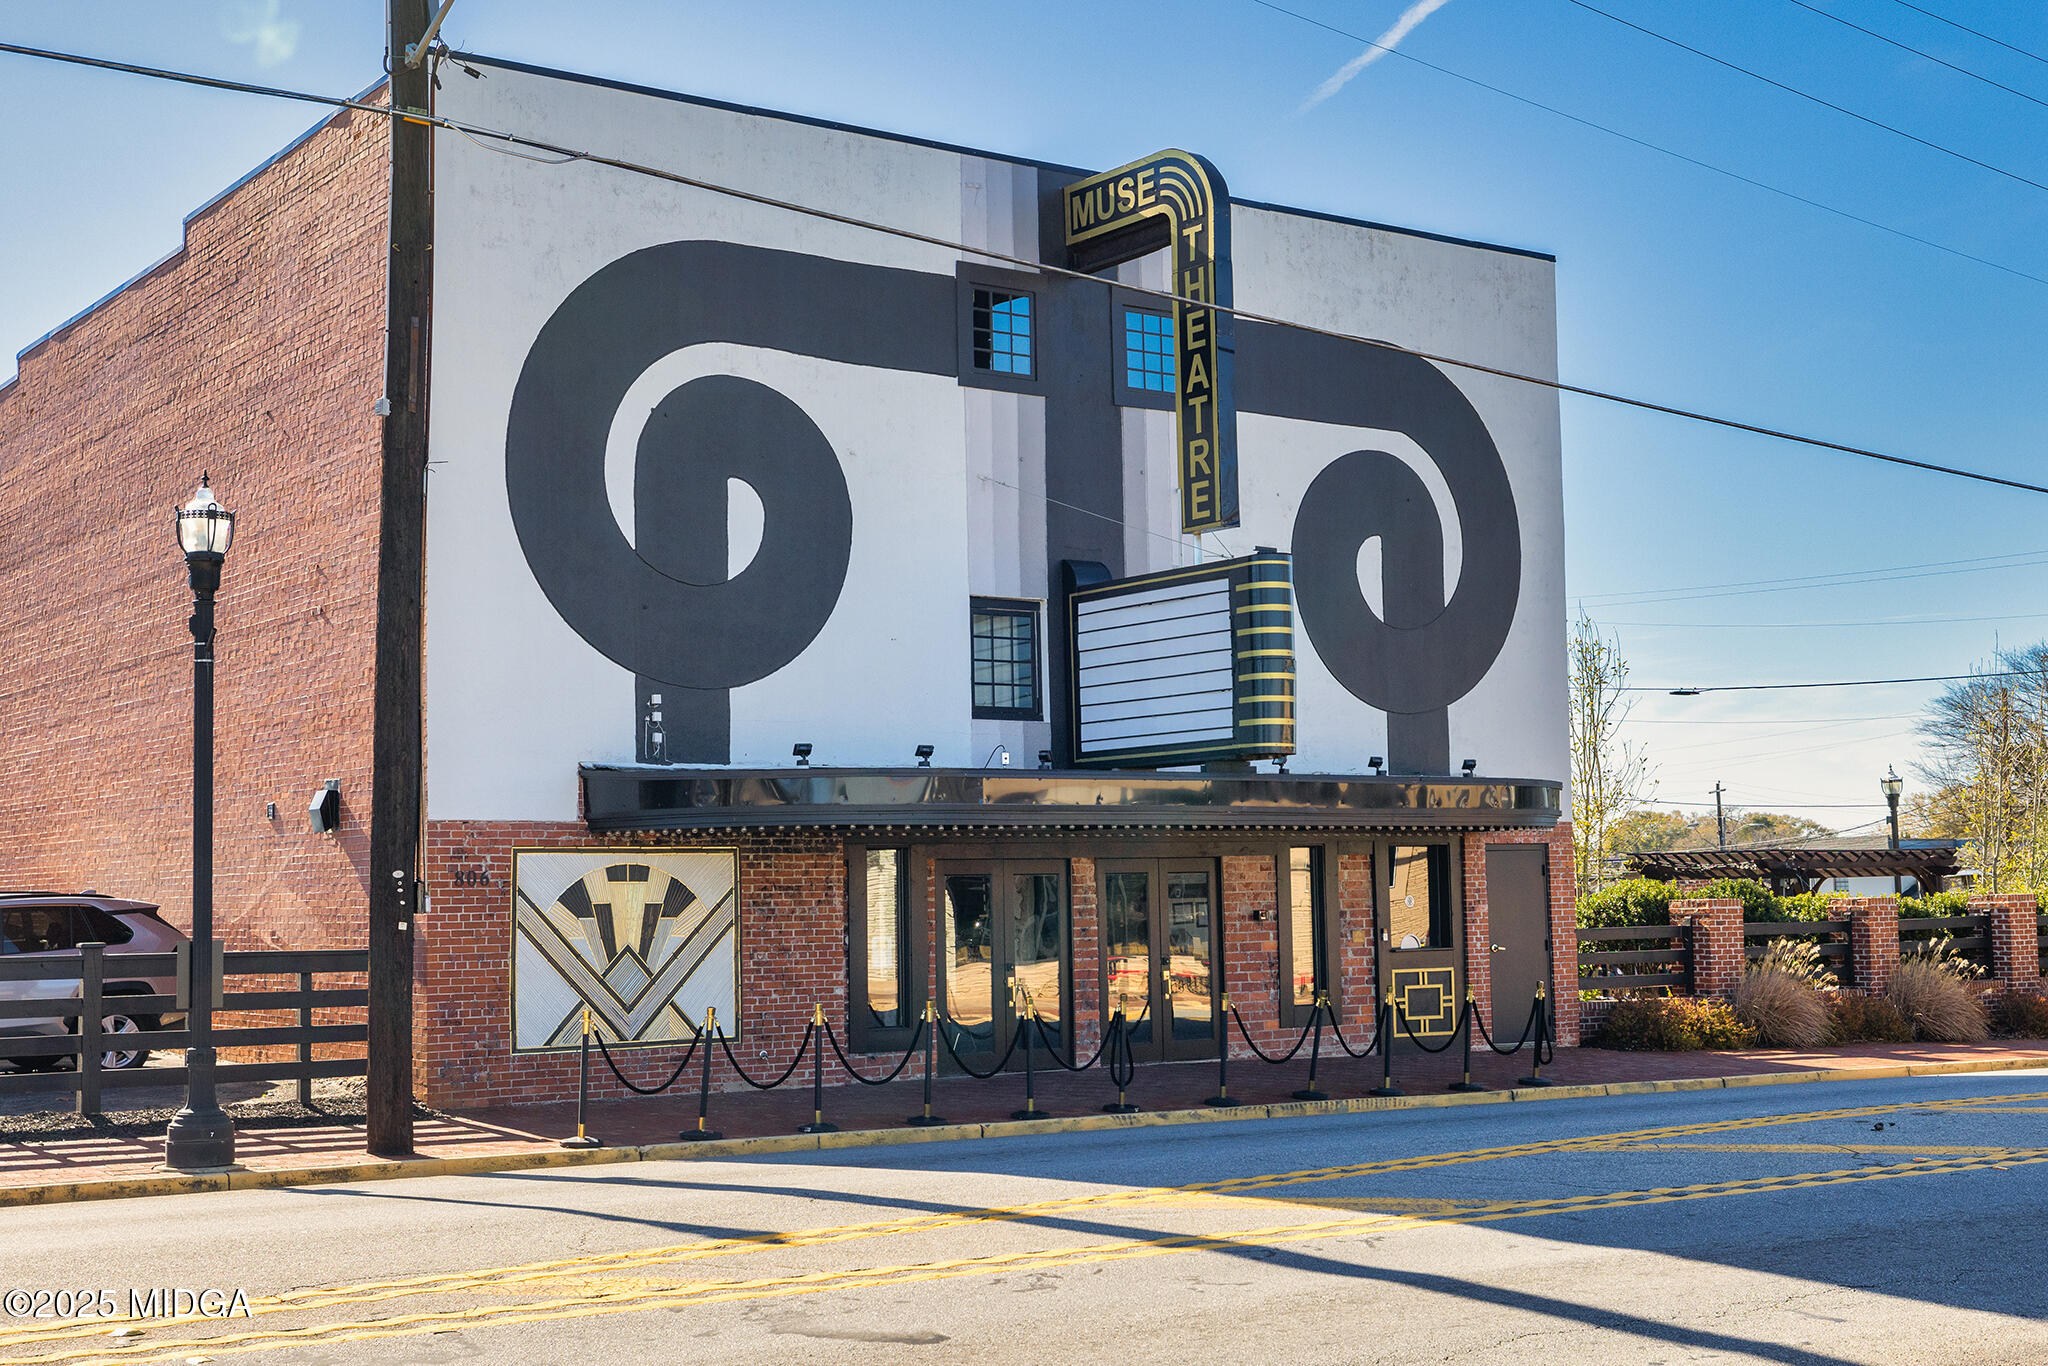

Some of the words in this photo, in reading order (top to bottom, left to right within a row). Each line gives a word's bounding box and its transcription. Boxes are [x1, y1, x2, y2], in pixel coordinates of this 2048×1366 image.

[1072, 168, 1157, 231] MUSE
[1182, 224, 1211, 520] THEATRE
[455, 870, 490, 887] 806
